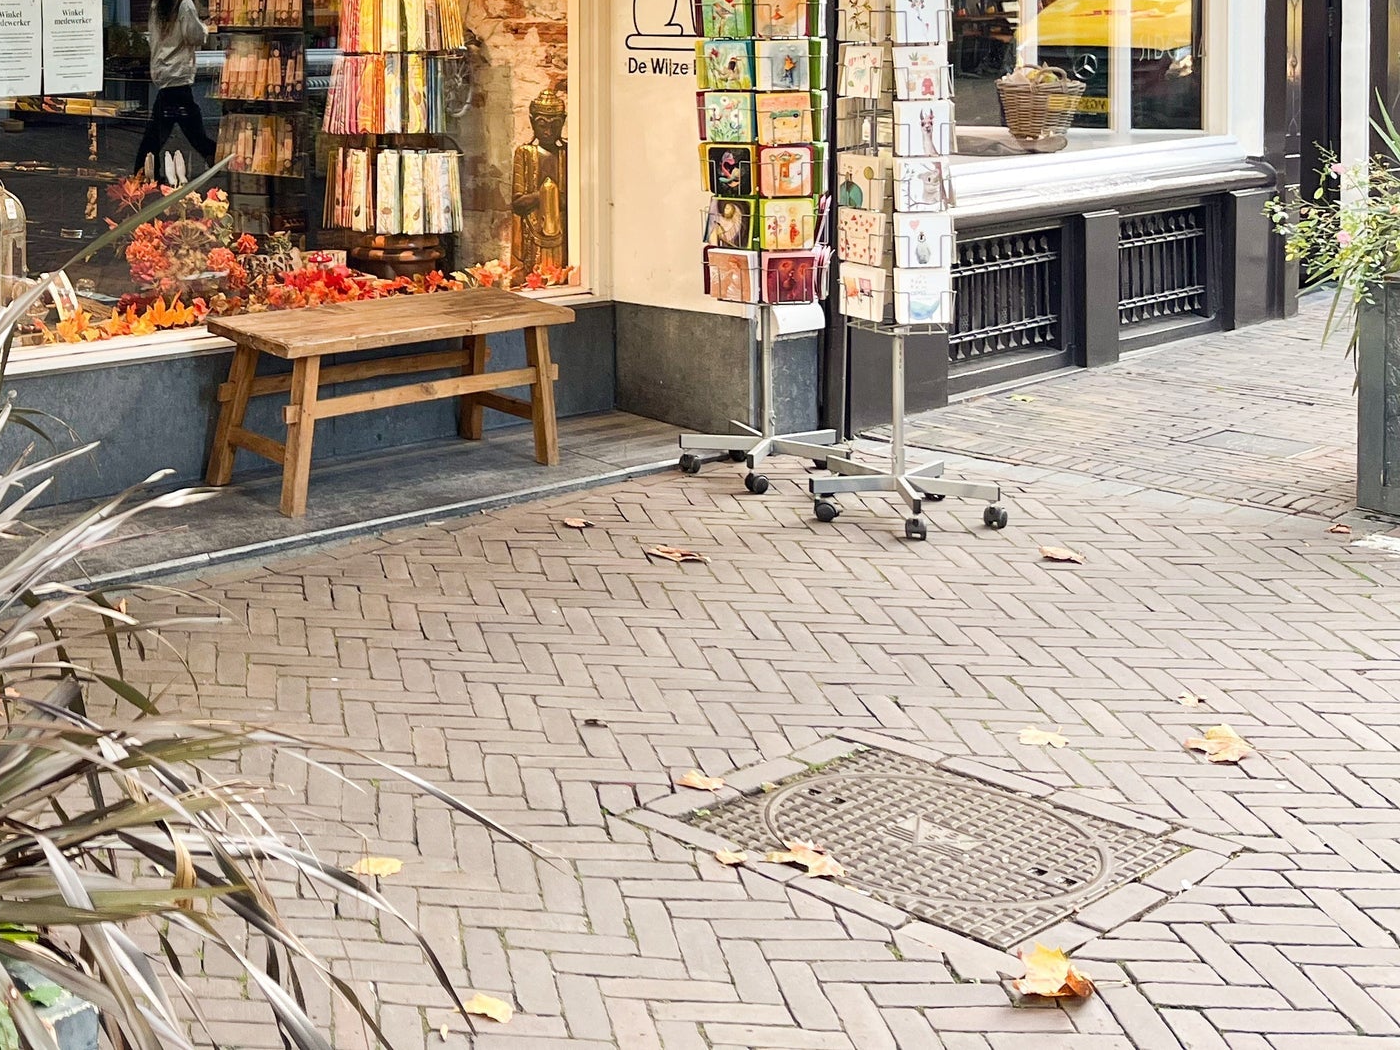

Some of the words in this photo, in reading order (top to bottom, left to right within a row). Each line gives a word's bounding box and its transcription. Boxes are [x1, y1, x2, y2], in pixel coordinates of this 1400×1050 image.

[0, 11, 22, 19] Winkel
[62, 9, 84, 17] Winkel
[54, 17, 92, 25] medewerker
[628, 57, 647, 73] De
